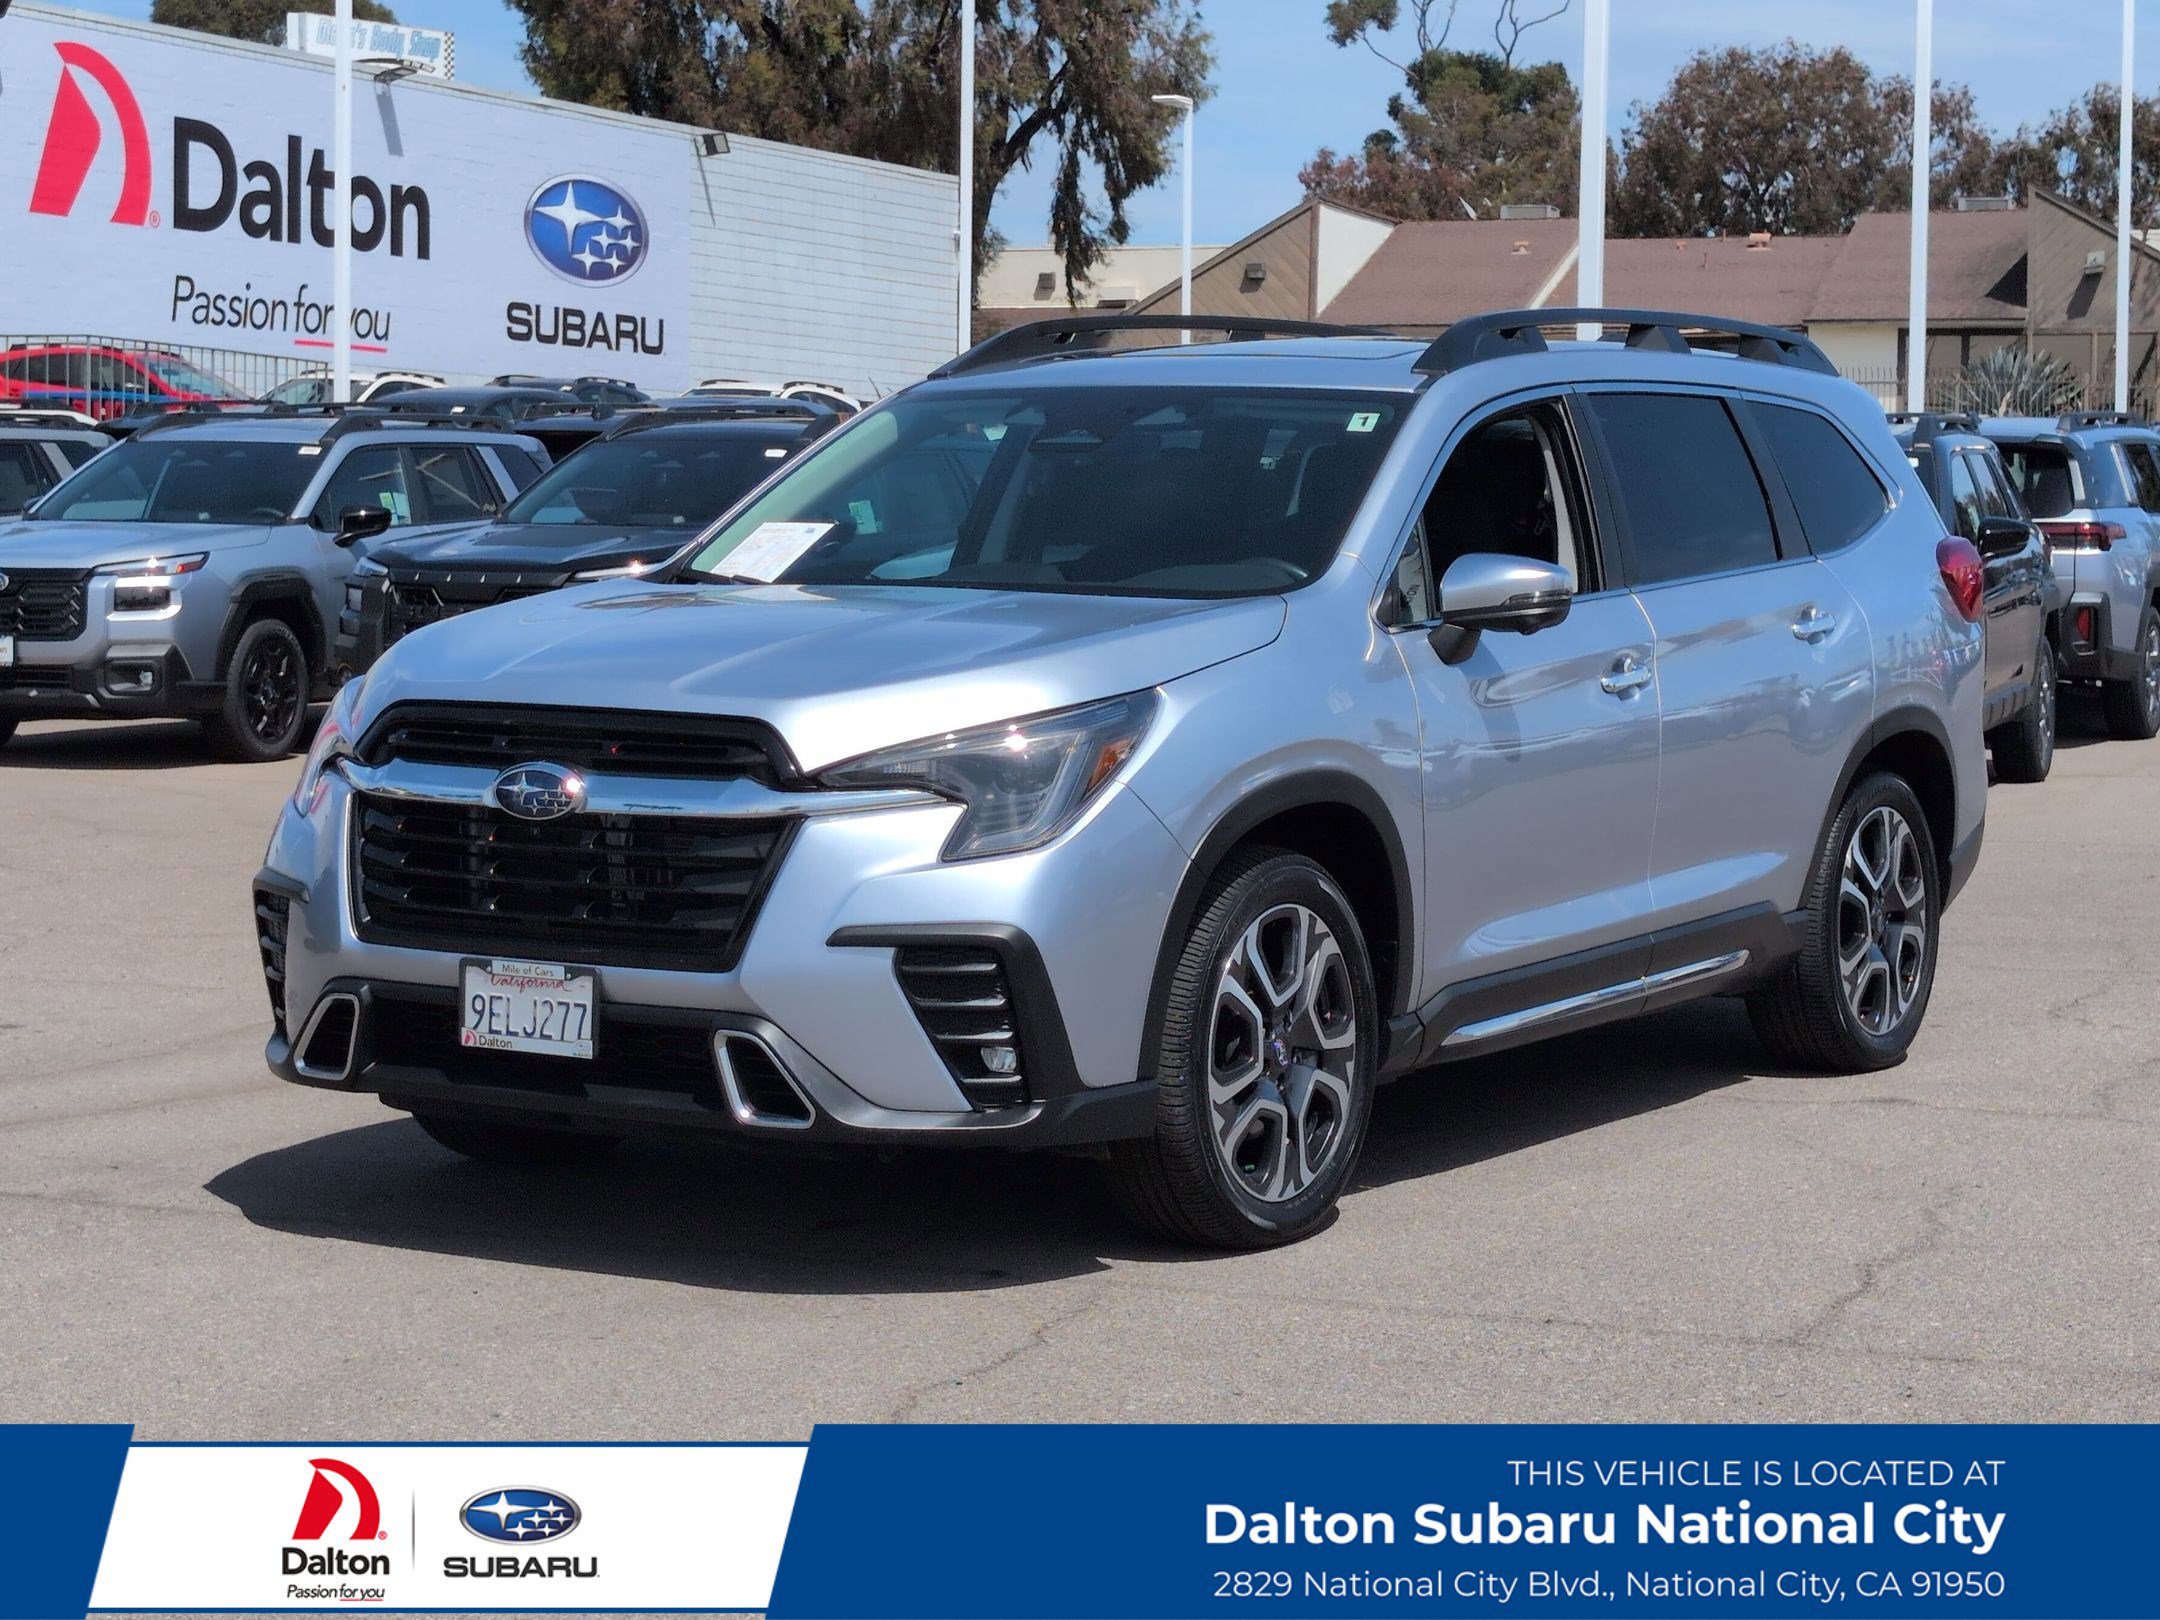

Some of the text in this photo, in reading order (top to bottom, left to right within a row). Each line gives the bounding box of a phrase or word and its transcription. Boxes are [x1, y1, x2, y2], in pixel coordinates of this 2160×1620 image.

[369, 24, 405, 61] Body
[407, 30, 441, 63] Shop
[173, 116, 431, 261] Dalton
[172, 275, 391, 342] Passion for ou
[506, 301, 665, 356] SUBARU
[502, 963, 554, 977] Mile of Cars
[471, 993, 588, 1042] 9ELJ277
[478, 1034, 513, 1049] Dalton
